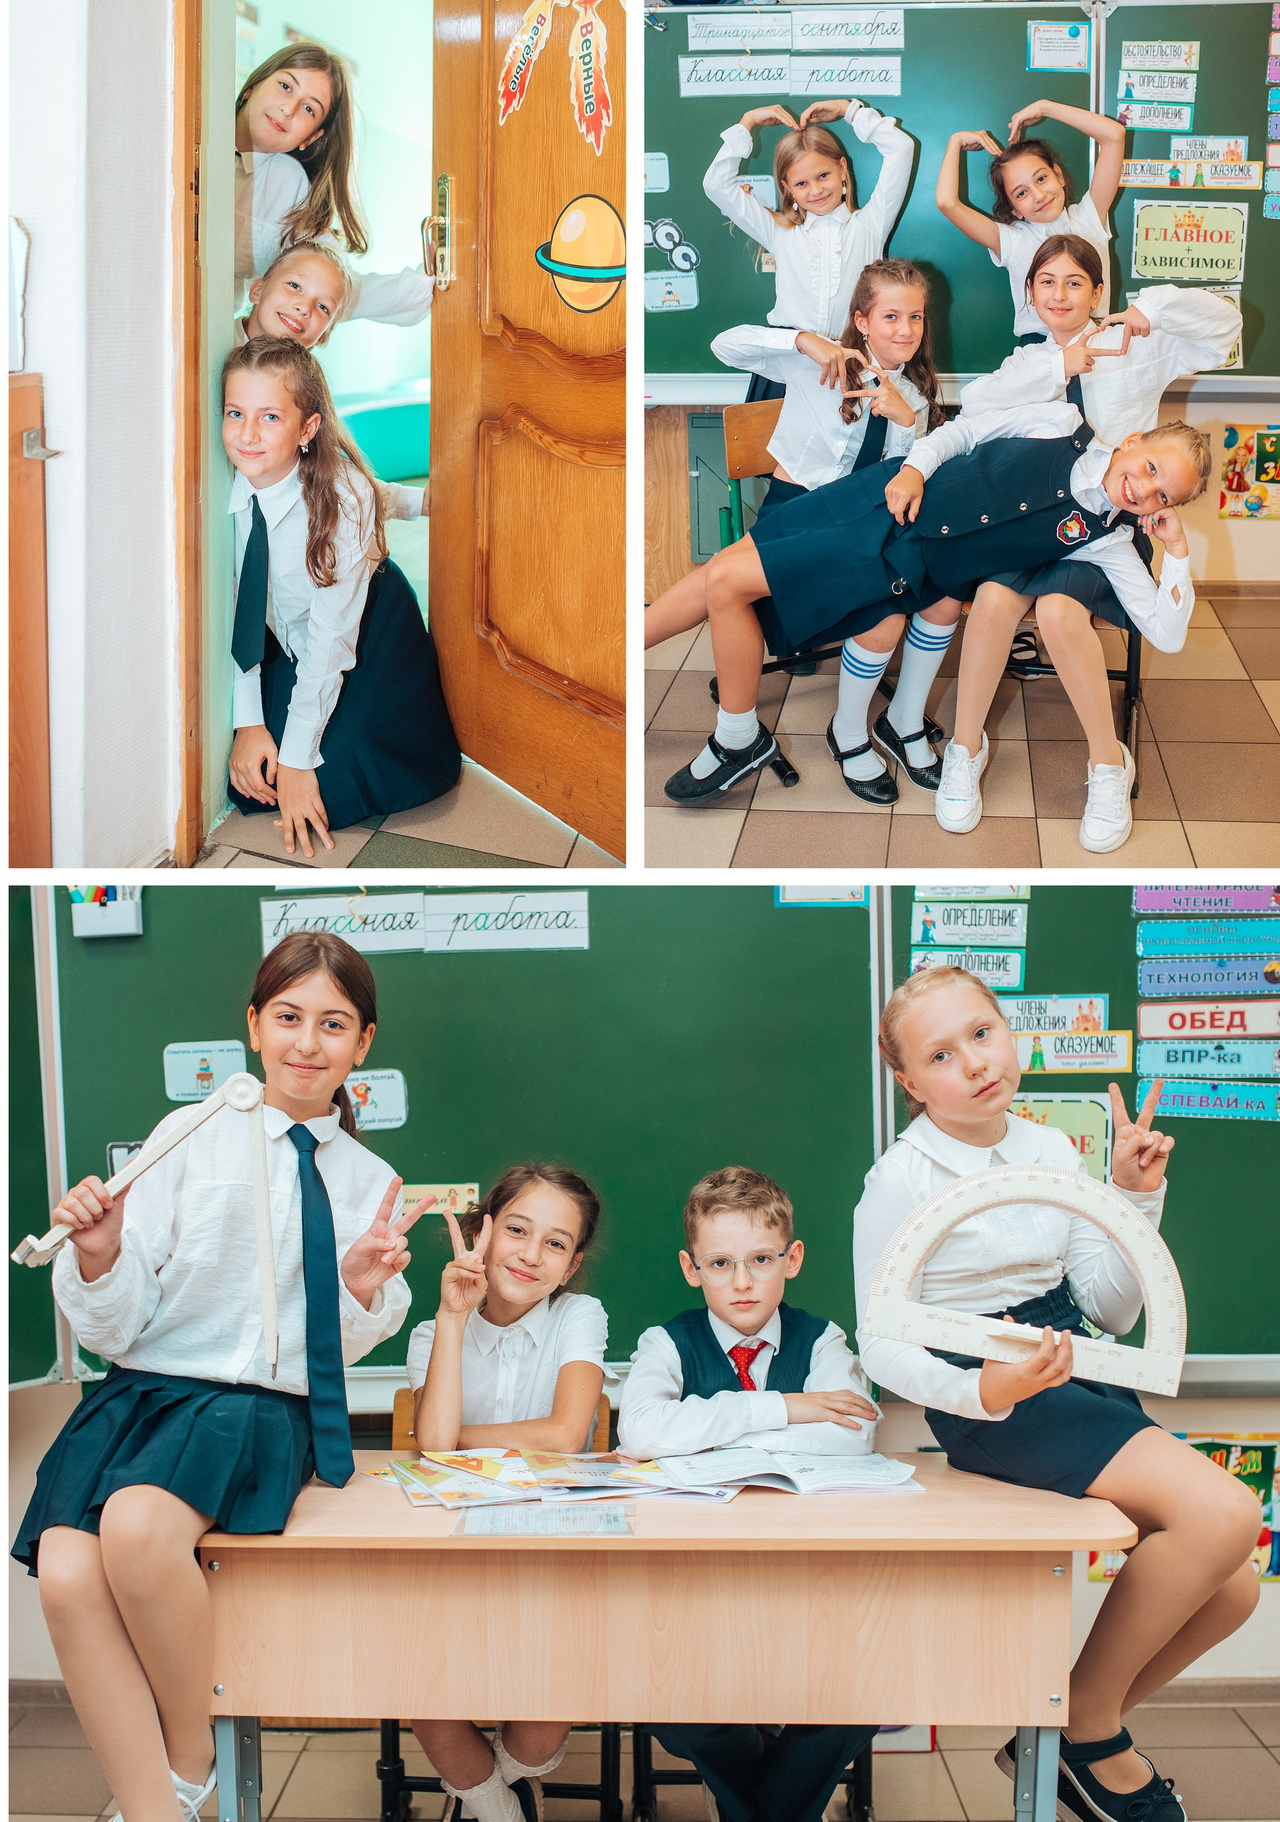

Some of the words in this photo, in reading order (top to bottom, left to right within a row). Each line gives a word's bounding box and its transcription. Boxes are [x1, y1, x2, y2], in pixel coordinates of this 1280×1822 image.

[800, 11, 901, 46] сентября
[509, 13, 547, 91] Весёлые
[1124, 45, 1182, 57] ОБСТОЯТЕЛЬСТВО
[579, 21, 597, 115] Верные
[687, 59, 787, 82] Классная
[1139, 75, 1190, 90] ОПРЕДЕЛЕНИЕ
[1139, 106, 1184, 120] ДОПОЛНЕНИЕ
[1187, 140, 1208, 149] ЧЛЕНЫ
[1173, 150, 1220, 161] ПРЕДЛОЖЕНИЯ
[1121, 163, 1165, 176] ОДЛЕЖАЩЕЕ
[1210, 164, 1253, 177] СКАЗУЕМОЕ
[1144, 228, 1236, 244] ГЛАВНОЕ
[1140, 256, 1236, 270] ЗАВИСИМОЕ
[1173, 897, 1234, 908] ЧТЕНИЕ
[273, 902, 419, 936] Классная
[942, 908, 1018, 928] ОПРЕДЕЛЕНИЕ
[1187, 926, 1237, 934] ОСНОВЫ
[1146, 971, 1259, 984] ТЕХНОЛОГИЯ
[1016, 1001, 1047, 1015] ЧЛЕНЫ
[1168, 1011, 1248, 1032] ОБЕД
[1054, 1036, 1117, 1054] СКАЗУЕМОЕ
[1165, 1050, 1241, 1064] ВПР-ка
